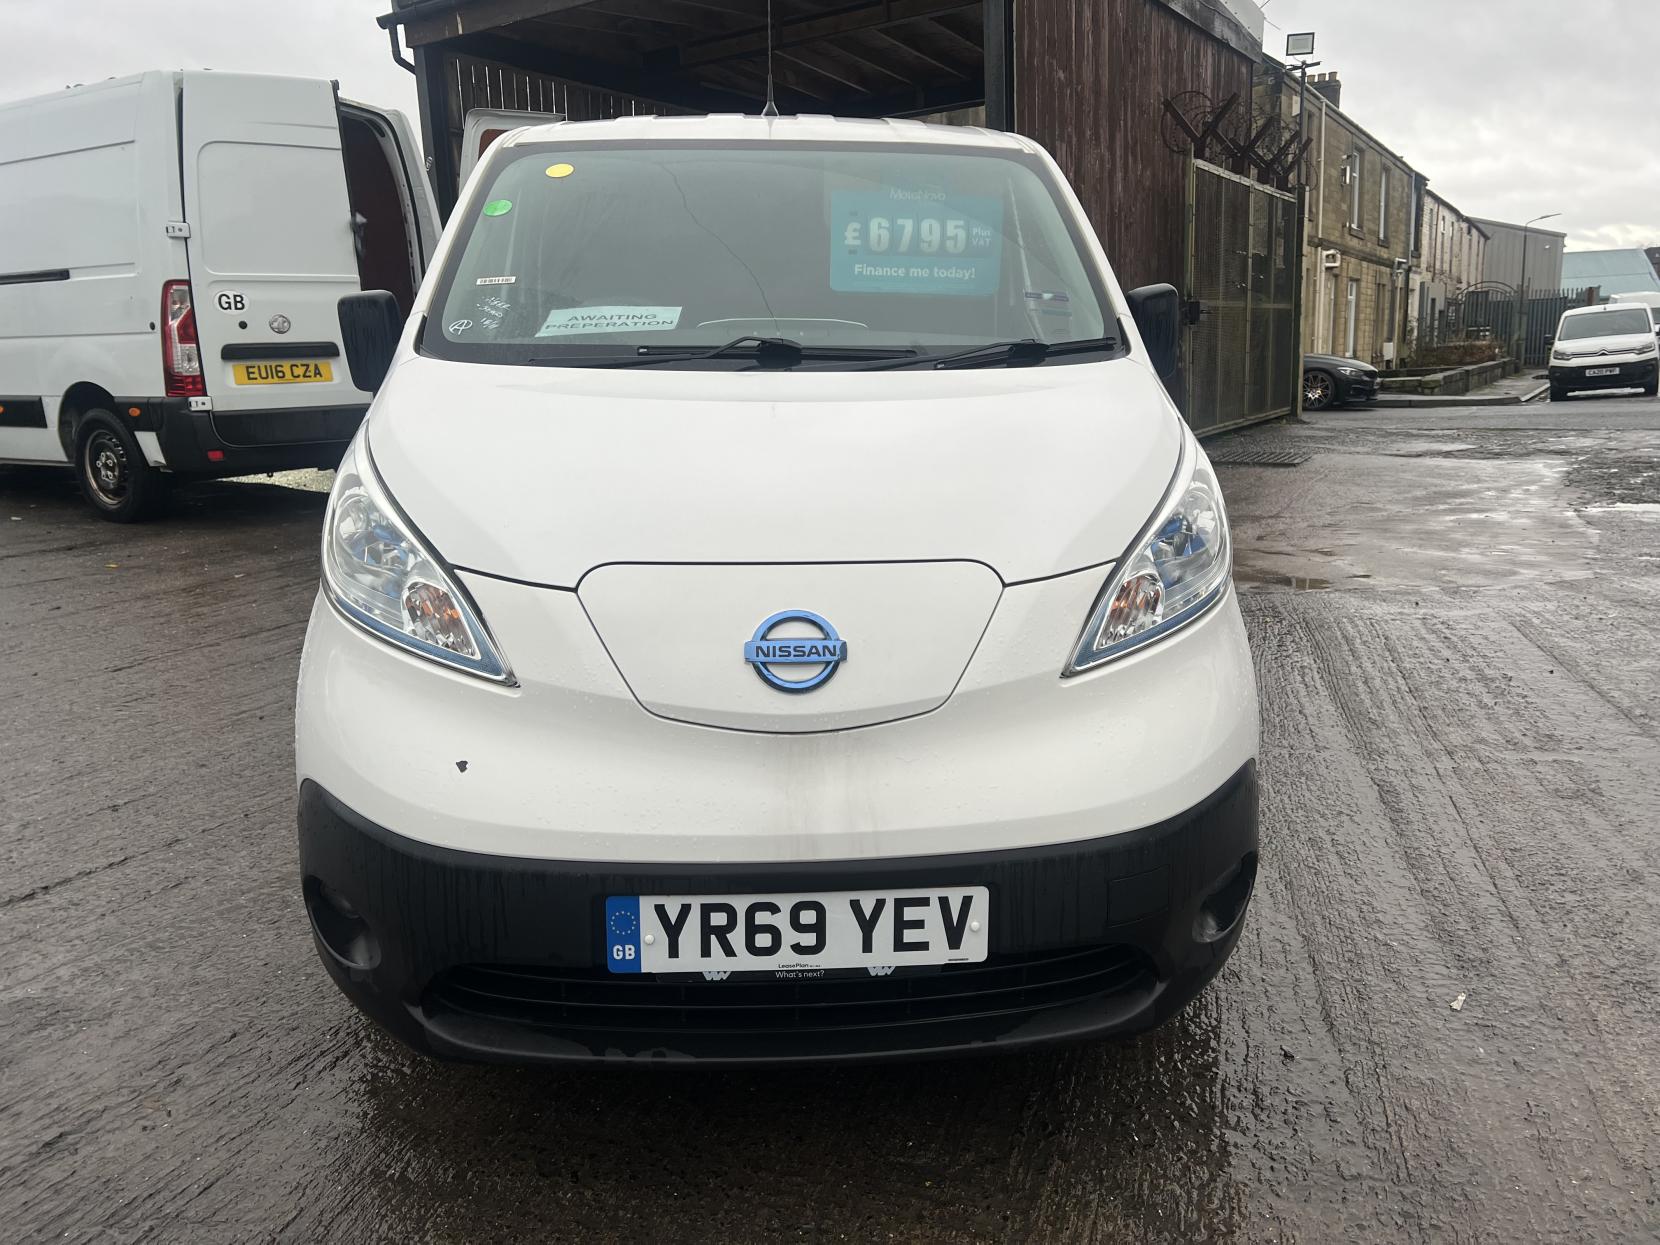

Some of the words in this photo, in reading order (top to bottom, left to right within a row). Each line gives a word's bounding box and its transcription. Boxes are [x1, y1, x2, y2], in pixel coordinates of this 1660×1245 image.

[854, 263, 906, 277] Finance
[909, 268, 930, 277] me
[933, 267, 976, 281] today!
[217, 293, 246, 311] GB
[544, 320, 674, 330] PREPERATION
[568, 313, 657, 322] AWAITING
[245, 364, 286, 381] EU16
[289, 363, 323, 379] CZA
[755, 644, 837, 658] NISSAN
[653, 900, 827, 959] YR69
[849, 895, 974, 954] YEV
[612, 944, 636, 960] GB
[775, 970, 803, 979] What's
[803, 969, 825, 978] next?
